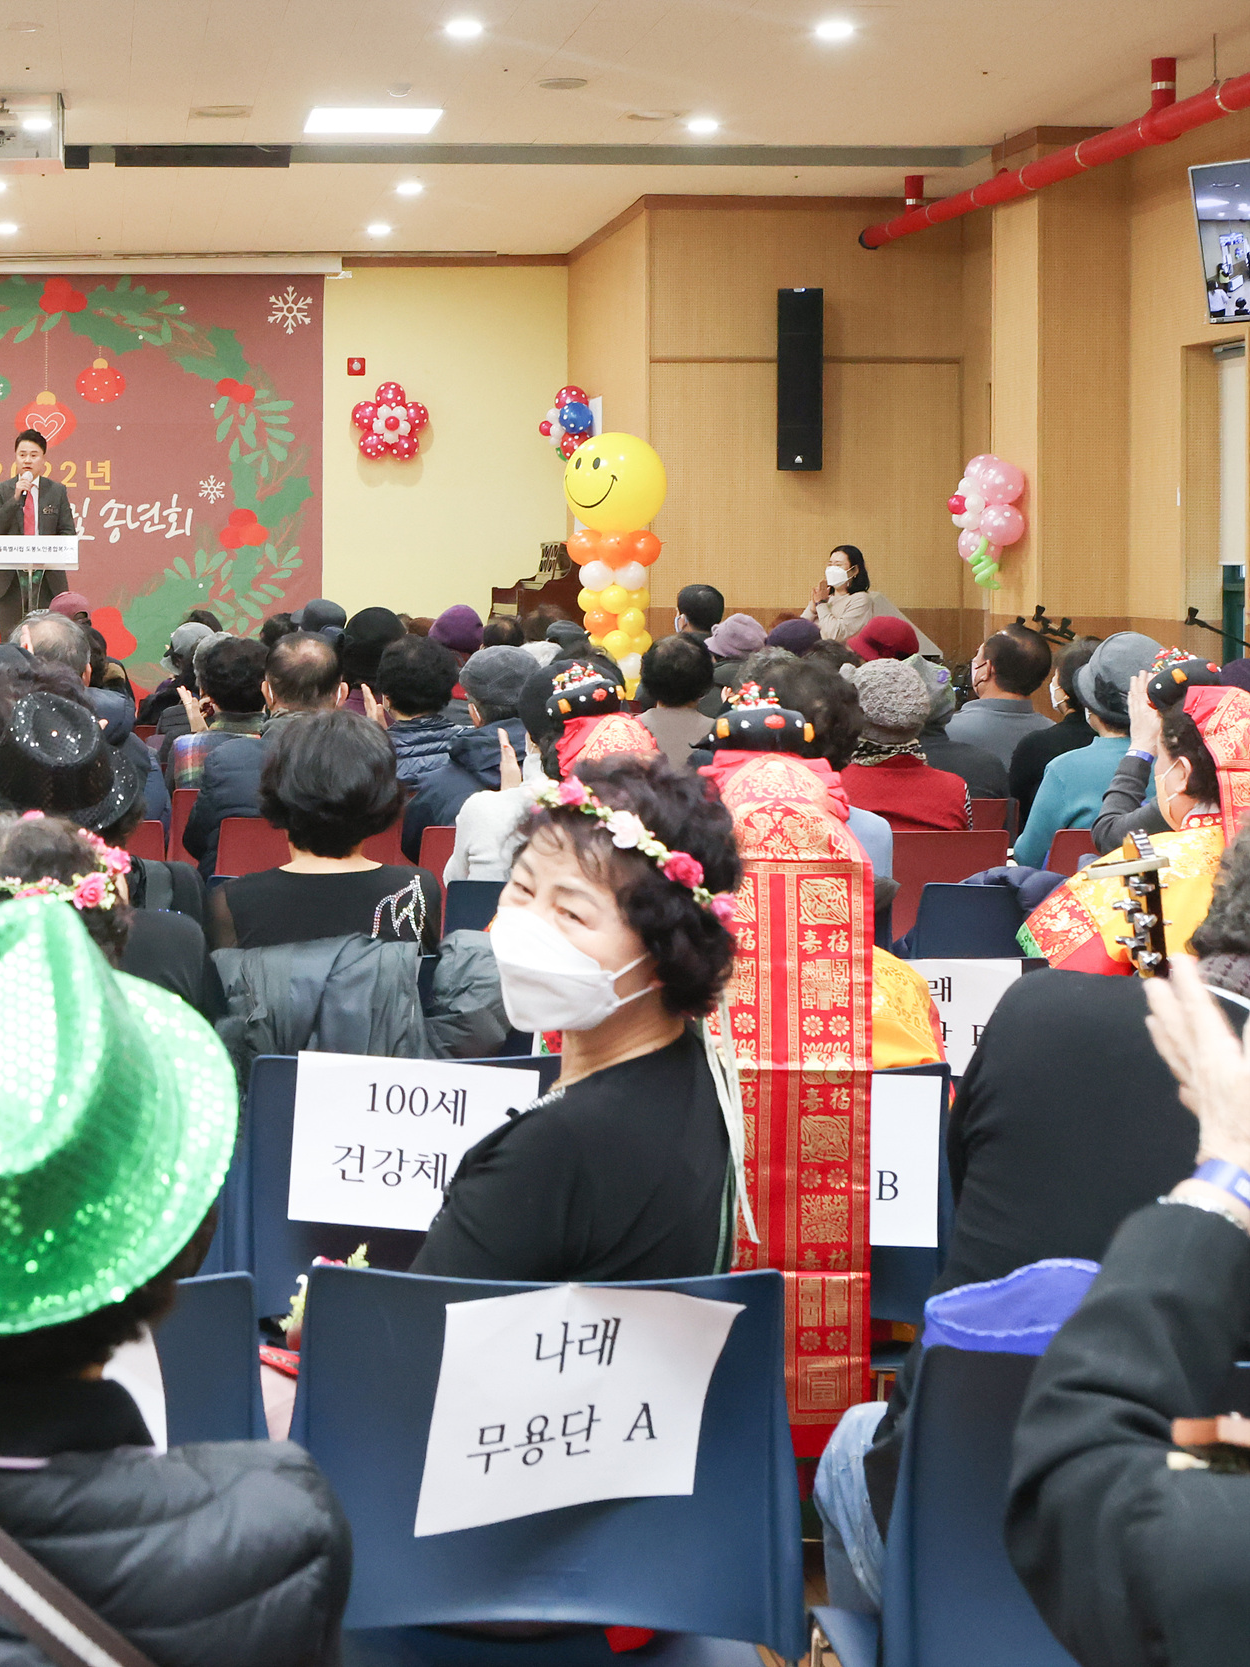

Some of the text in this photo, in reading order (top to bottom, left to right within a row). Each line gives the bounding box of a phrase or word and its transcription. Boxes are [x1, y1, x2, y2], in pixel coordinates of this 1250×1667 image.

[99, 493, 194, 544] 송년회
[927, 976, 952, 1003] 래
[366, 1082, 467, 1127] 100세
[331, 1143, 448, 1193] 건강체
[875, 1170, 899, 1201] B
[535, 1316, 622, 1374] 나래
[466, 1402, 658, 1475] 무용단 A
